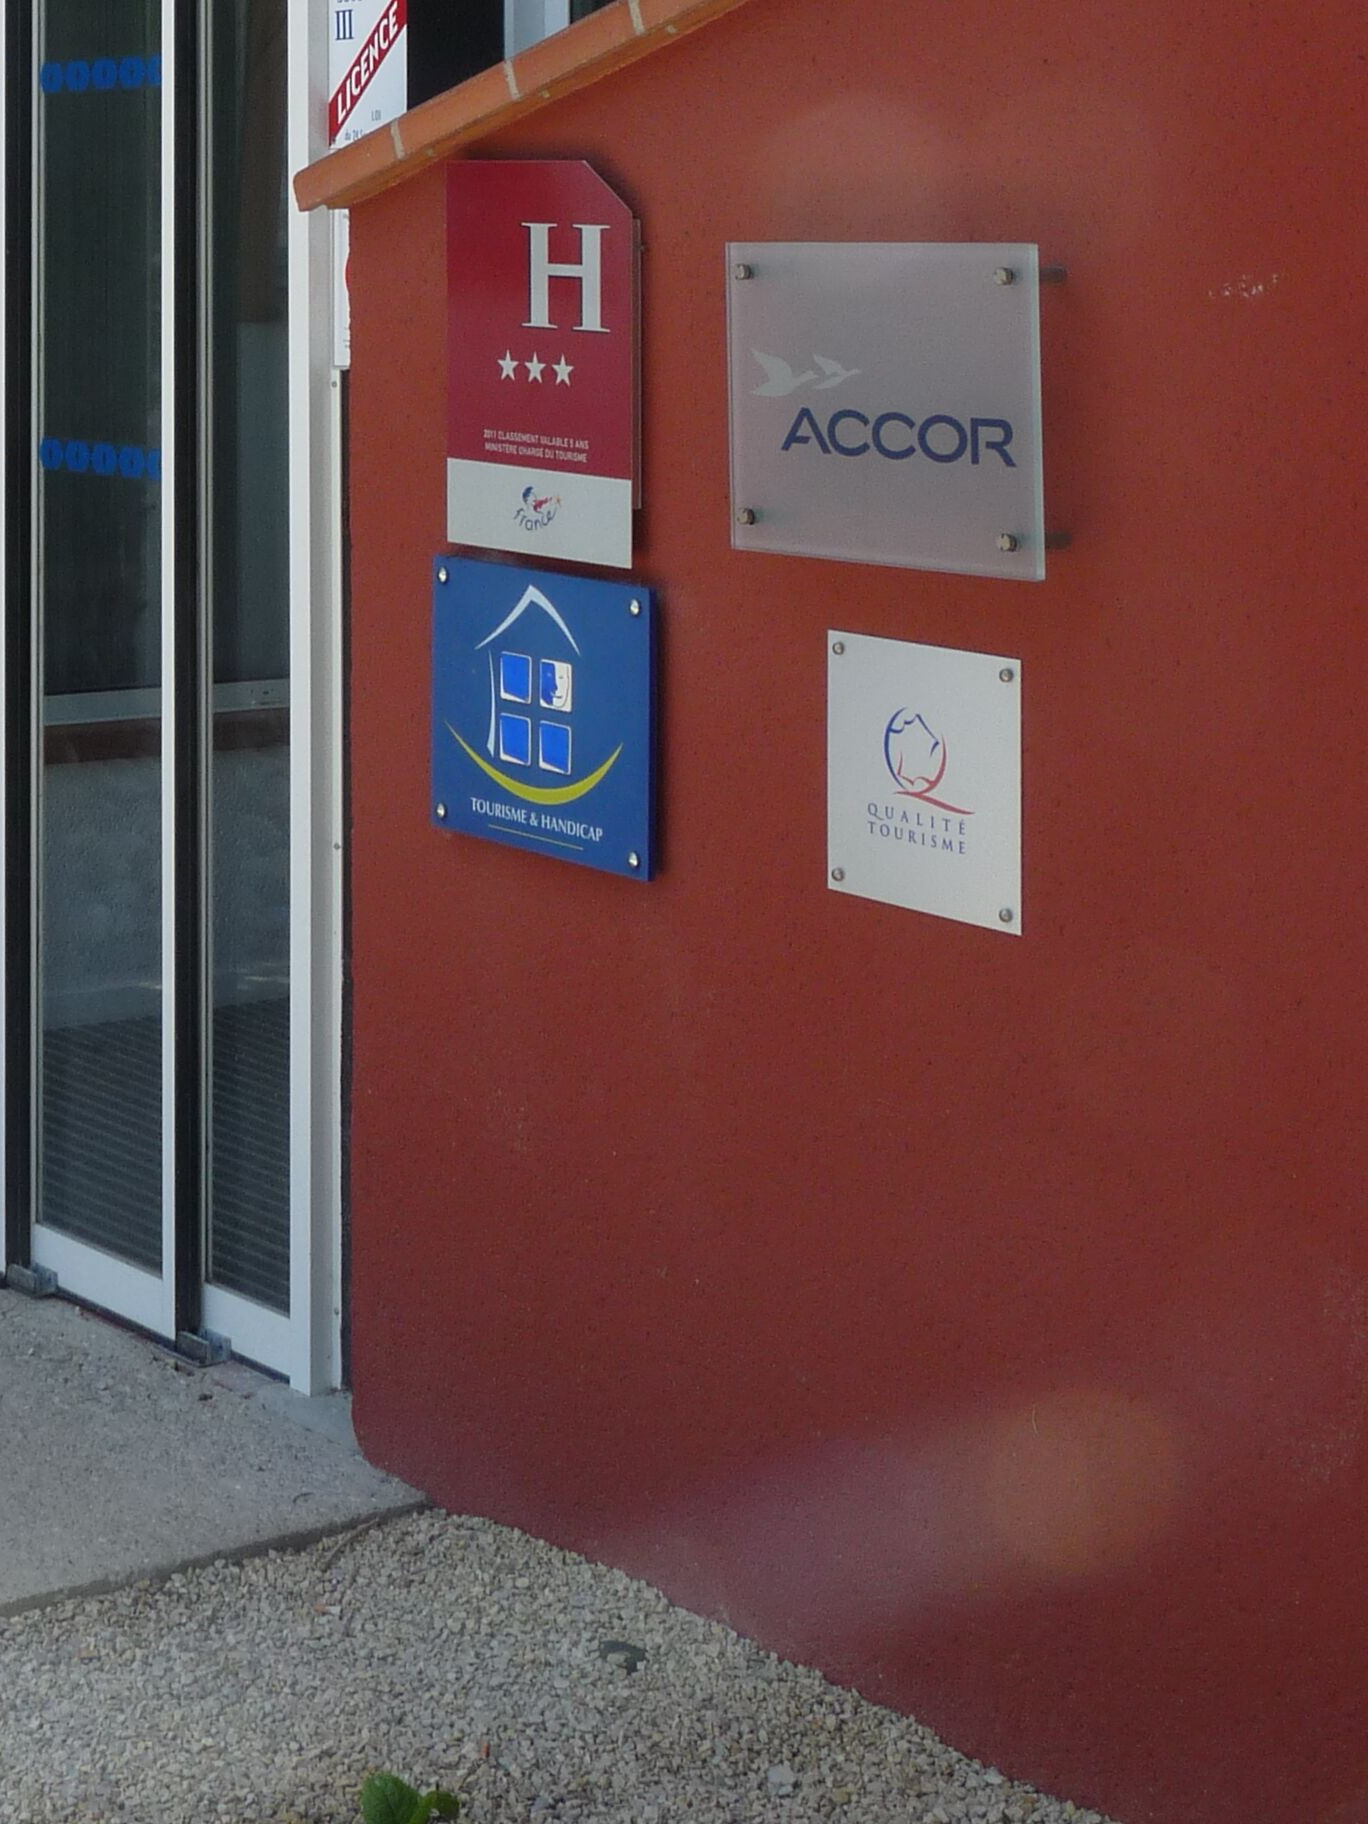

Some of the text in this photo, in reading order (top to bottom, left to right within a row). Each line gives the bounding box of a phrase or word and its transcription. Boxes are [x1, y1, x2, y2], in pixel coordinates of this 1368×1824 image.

[335, 8, 354, 41] III
[338, 0, 399, 125] LICENCE
[521, 221, 611, 333] H
[498, 430, 538, 443] CLASSEMENT
[540, 435, 569, 448] VALABLE
[575, 439, 589, 450] ANS
[781, 406, 1017, 468] ACCOR
[556, 450, 587, 463] TOURISME
[470, 796, 604, 843] TOURISME & HANDICAP
[867, 801, 967, 836] QUALITÉ
[867, 820, 967, 855] TOURISME
